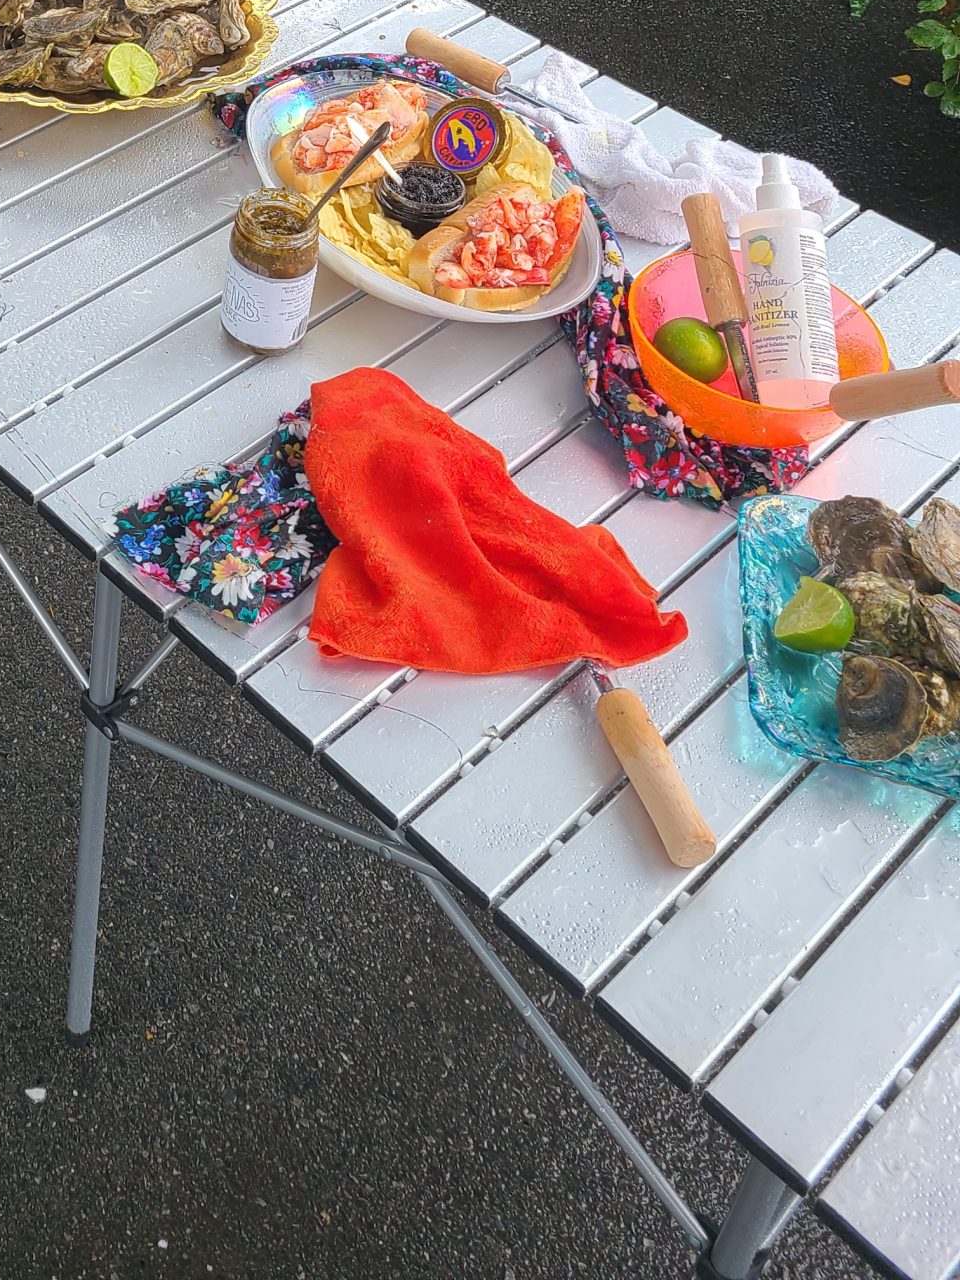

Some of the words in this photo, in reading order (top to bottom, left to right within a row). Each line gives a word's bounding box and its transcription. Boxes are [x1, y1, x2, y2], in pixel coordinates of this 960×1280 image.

[463, 111, 487, 131] EBO
[439, 146, 471, 166] CAVIAR
[753, 298, 783, 310] HAND
